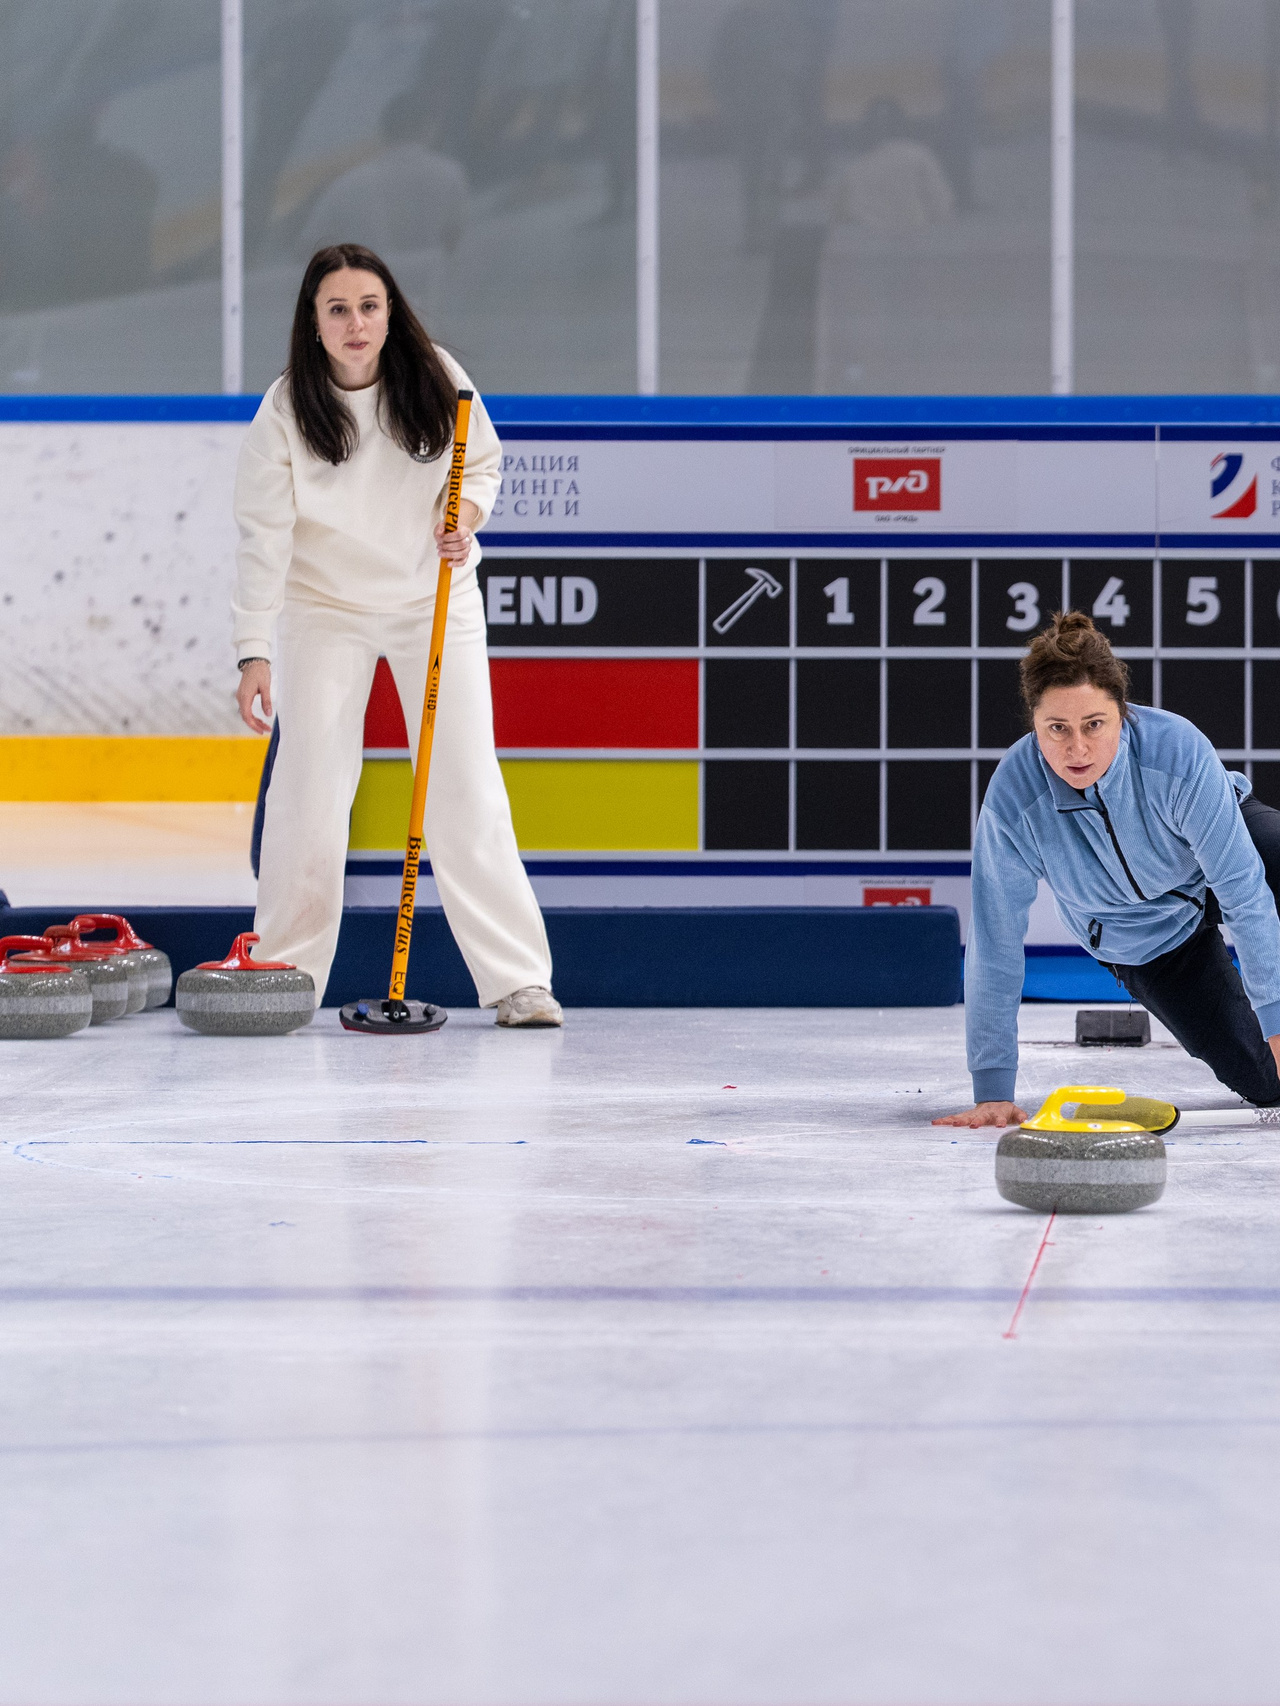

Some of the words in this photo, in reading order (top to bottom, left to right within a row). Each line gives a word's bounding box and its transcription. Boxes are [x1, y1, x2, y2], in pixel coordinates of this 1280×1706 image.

[499, 455, 580, 474] РАЦИЯ
[444, 442, 467, 534] BalancePl
[500, 478, 580, 496] ИНГА
[491, 499, 580, 518] ССИИ
[487, 576, 599, 625] END
[823, 577, 854, 624] 1
[913, 577, 946, 625] 2
[1006, 582, 1040, 631] 3
[1092, 577, 1130, 626] 4
[1186, 576, 1220, 625] 5
[394, 836, 422, 955] BalancePlus
